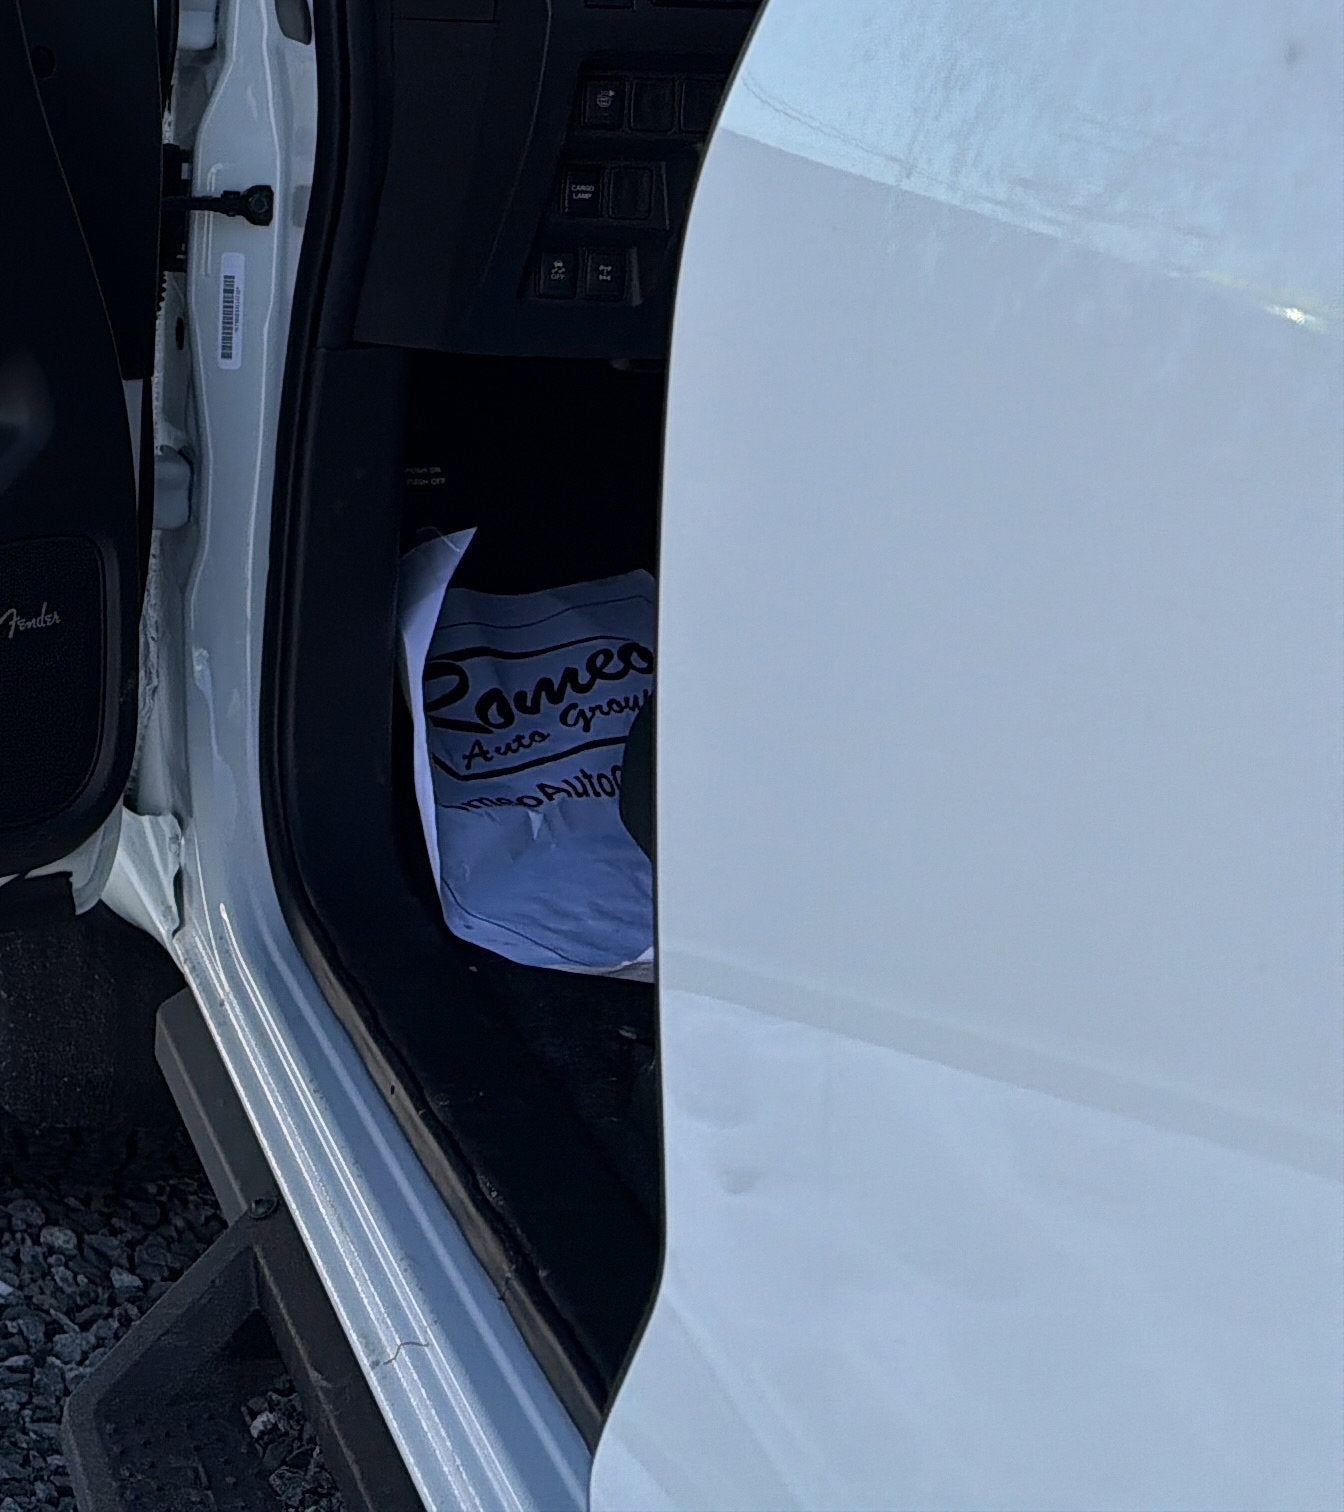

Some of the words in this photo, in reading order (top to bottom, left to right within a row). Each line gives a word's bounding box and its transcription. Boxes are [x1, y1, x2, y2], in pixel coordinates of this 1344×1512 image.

[570, 184, 595, 192] CARGO
[572, 192, 593, 200] LAMP
[423, 642, 654, 734] Romeo
[462, 730, 551, 771] Auto
[559, 688, 654, 733] Grou
